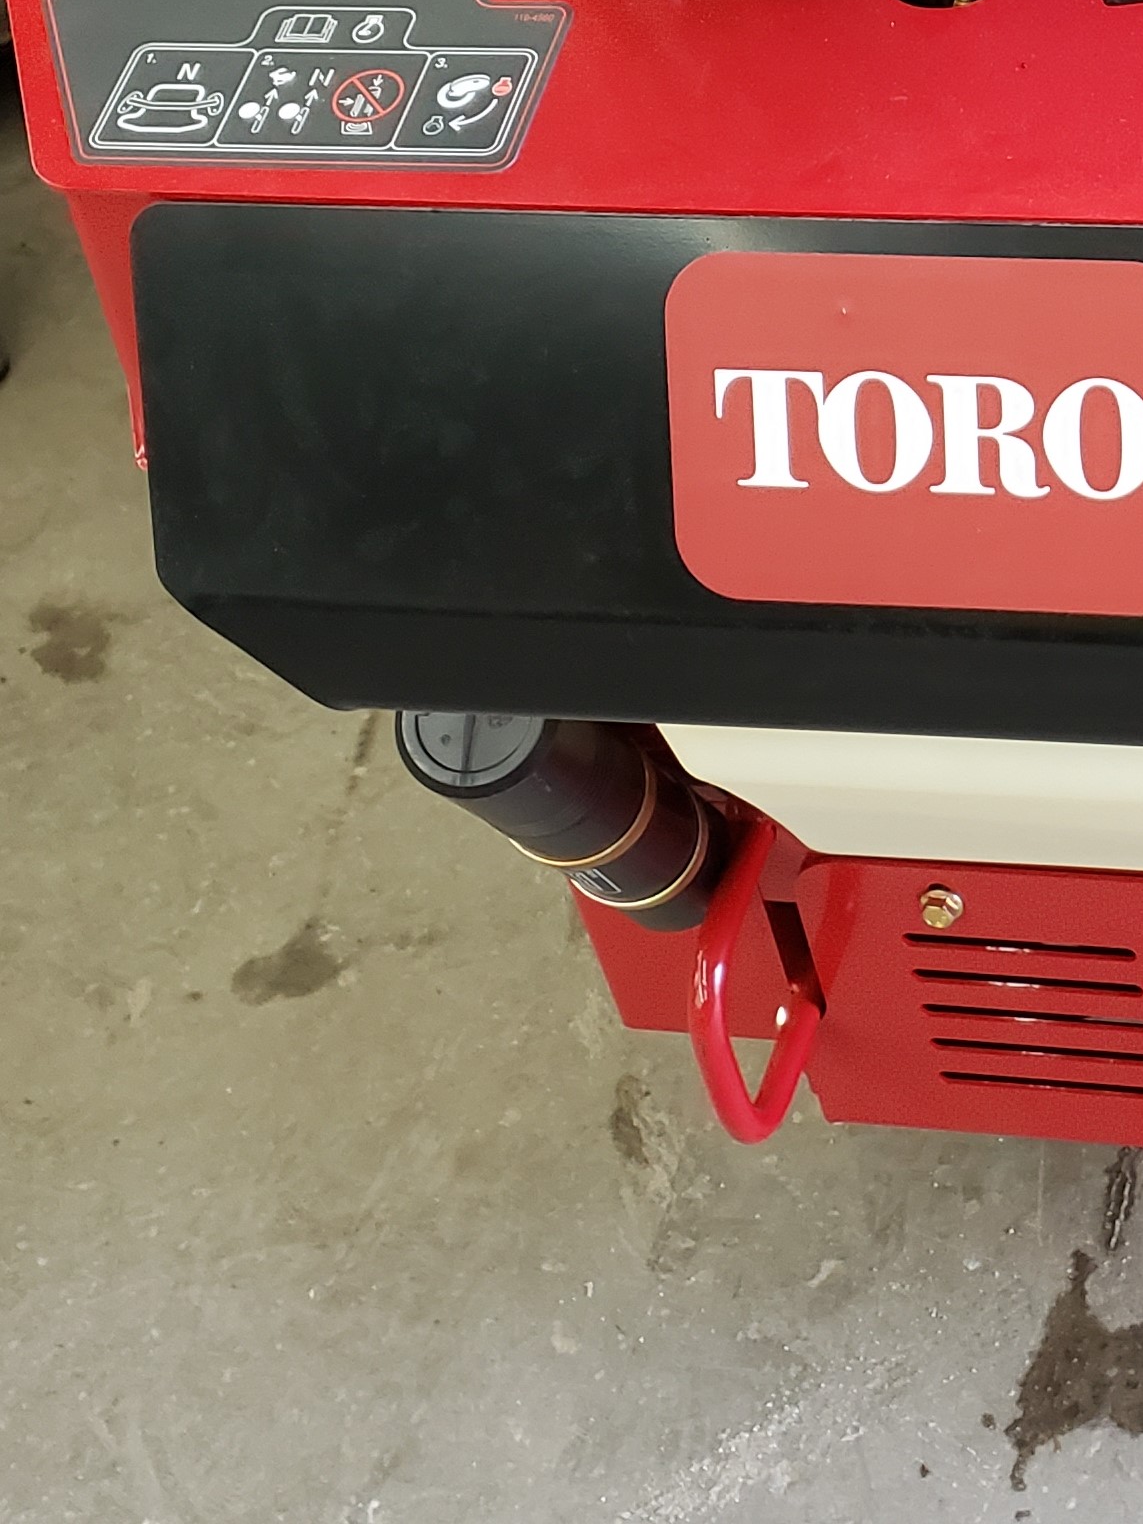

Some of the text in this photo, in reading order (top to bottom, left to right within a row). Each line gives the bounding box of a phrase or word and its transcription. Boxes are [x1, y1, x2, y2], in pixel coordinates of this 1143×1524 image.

[146, 52, 157, 64] 1.
[260, 54, 274, 67] 2.
[434, 57, 448, 69] 3.
[176, 62, 201, 81] N
[308, 68, 335, 87] N
